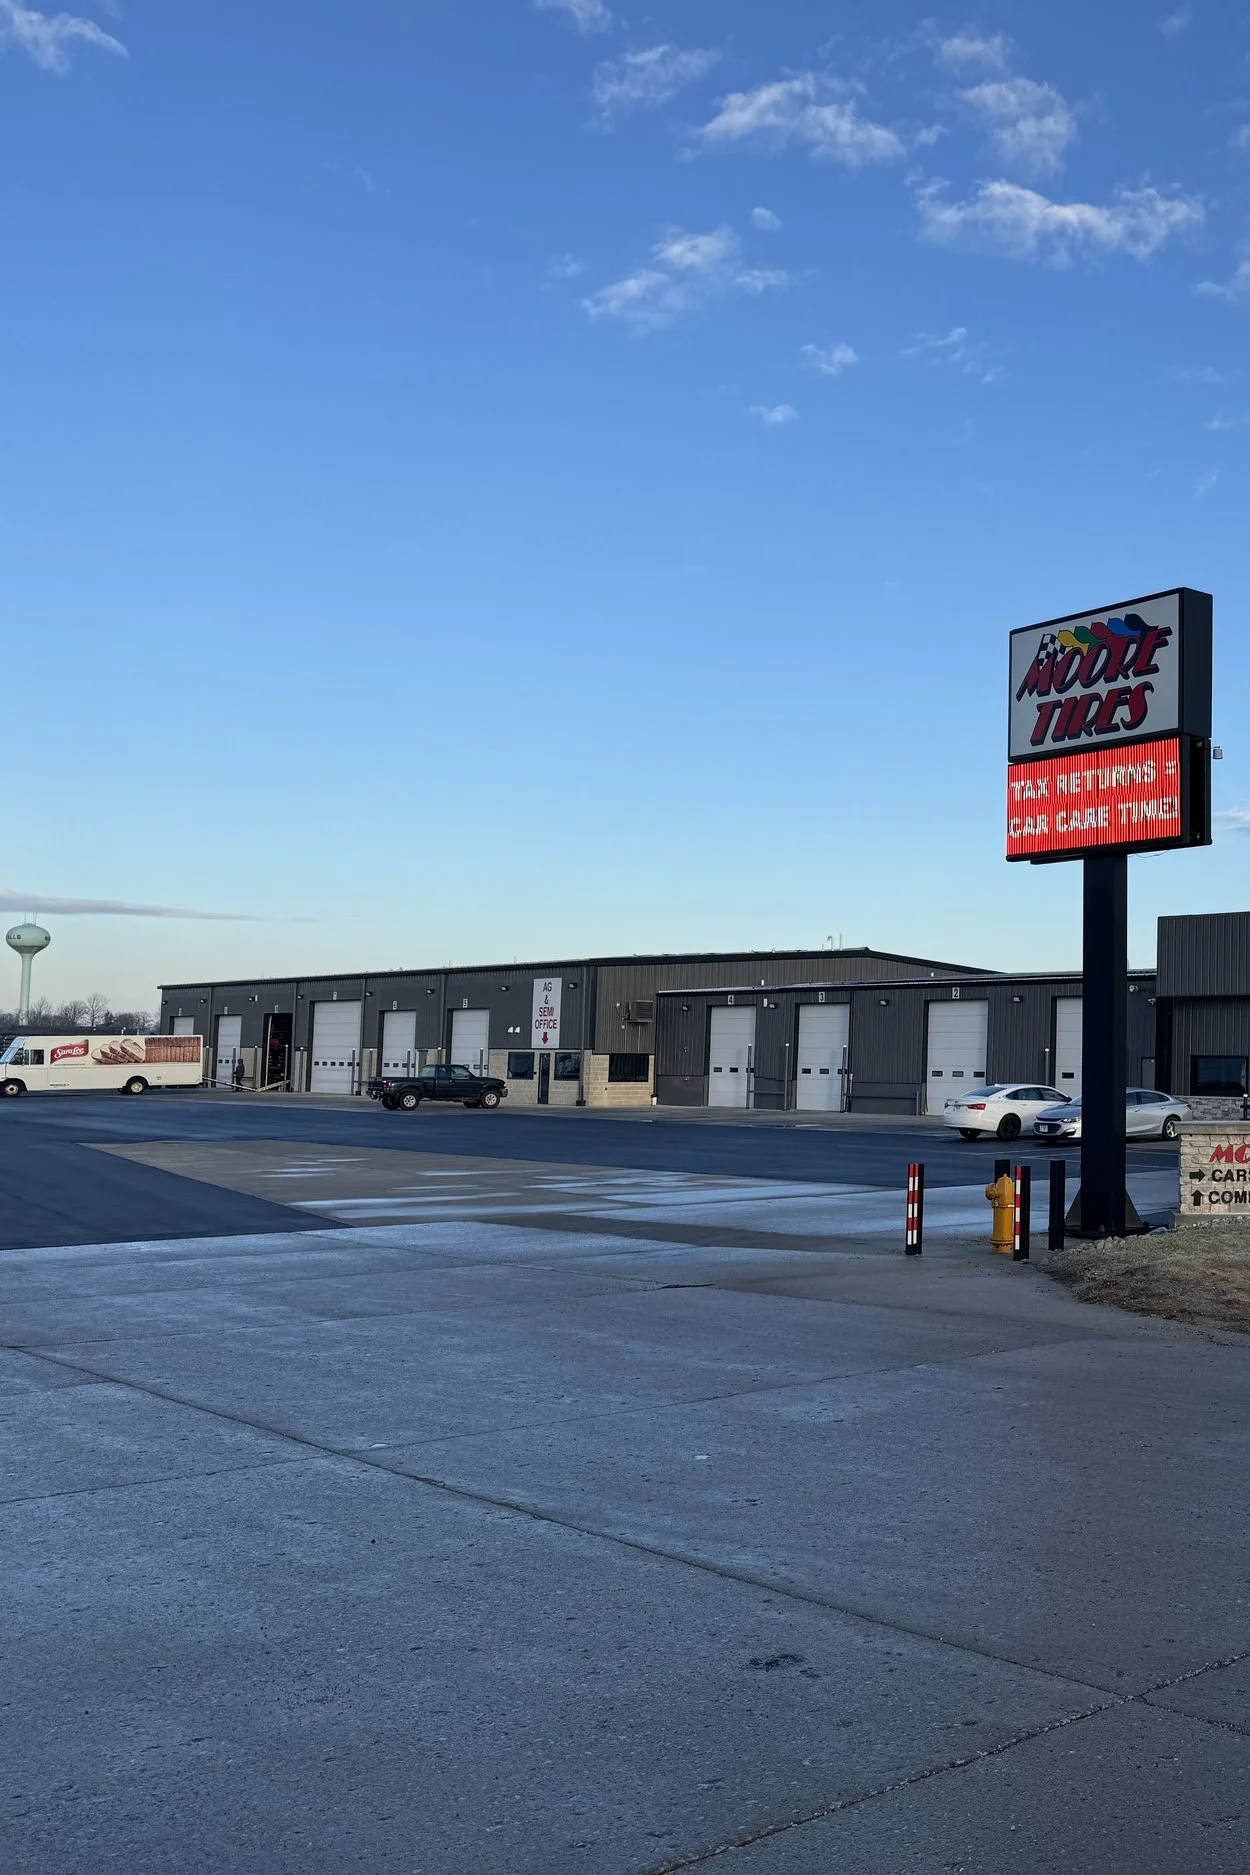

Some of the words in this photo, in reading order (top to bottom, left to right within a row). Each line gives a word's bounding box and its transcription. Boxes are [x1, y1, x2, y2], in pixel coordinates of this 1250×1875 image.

[1016, 626, 1173, 702] MOORE
[1030, 681, 1154, 746] TIRES
[1011, 776, 1050, 802] TAX
[1057, 760, 1156, 796] RETURNS
[1009, 814, 1049, 839] CAR
[1056, 805, 1110, 833] CARE
[1118, 796, 1179, 825] TIME!
[542, 981, 552, 993] AG
[543, 994, 549, 1005] &
[538, 1006, 555, 1017] SEMI
[534, 1018, 558, 1030] OFFICE
[54, 1048, 73, 1059] Sara
[72, 1046, 85, 1056] Lee
